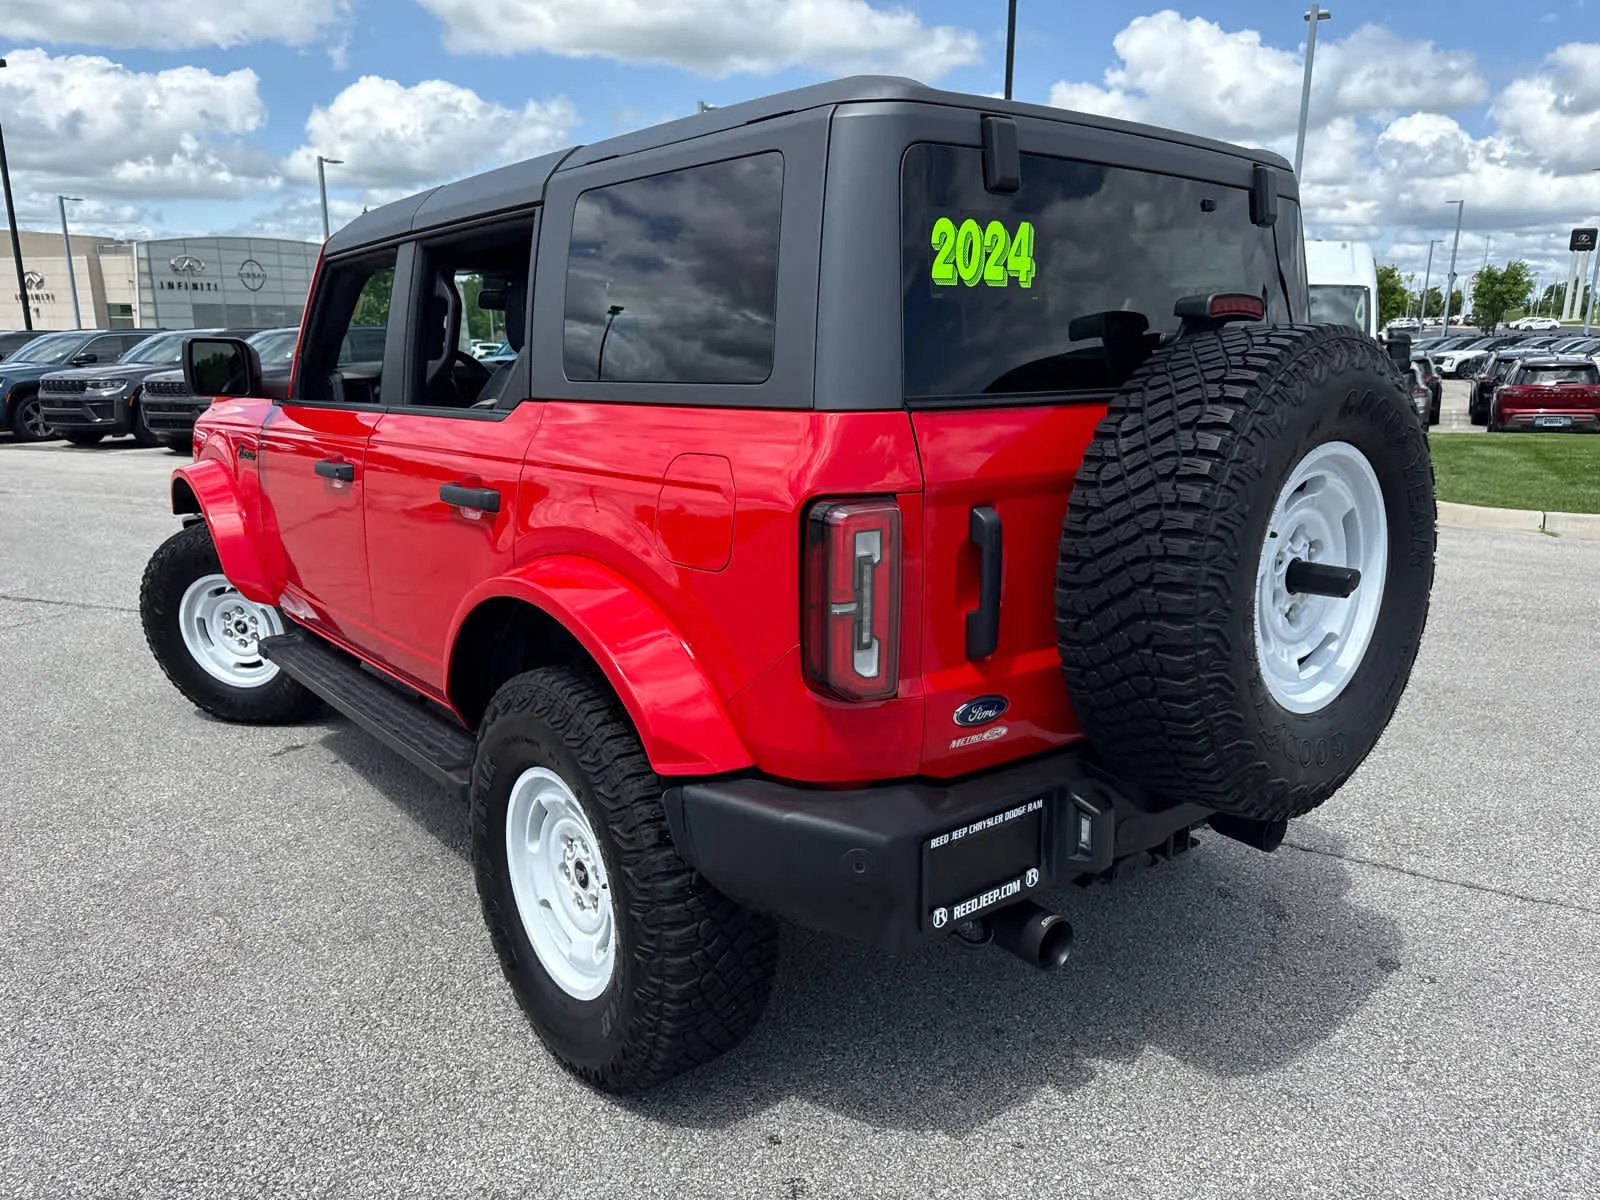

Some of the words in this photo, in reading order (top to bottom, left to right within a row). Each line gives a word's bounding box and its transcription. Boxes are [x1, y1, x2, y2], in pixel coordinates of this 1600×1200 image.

[931, 217, 1036, 288] 2024
[160, 281, 218, 292] INFINITI
[14, 293, 56, 304] IINITI
[967, 705, 997, 722] Ford
[949, 733, 984, 750] METRO
[930, 834, 949, 849] REED
[950, 827, 967, 841] JEEP
[968, 813, 1004, 834] CHRYSLER
[1004, 806, 1026, 822] DODGE
[1027, 799, 1043, 814] RAM
[953, 880, 1021, 920] REEDJEEP.COM
